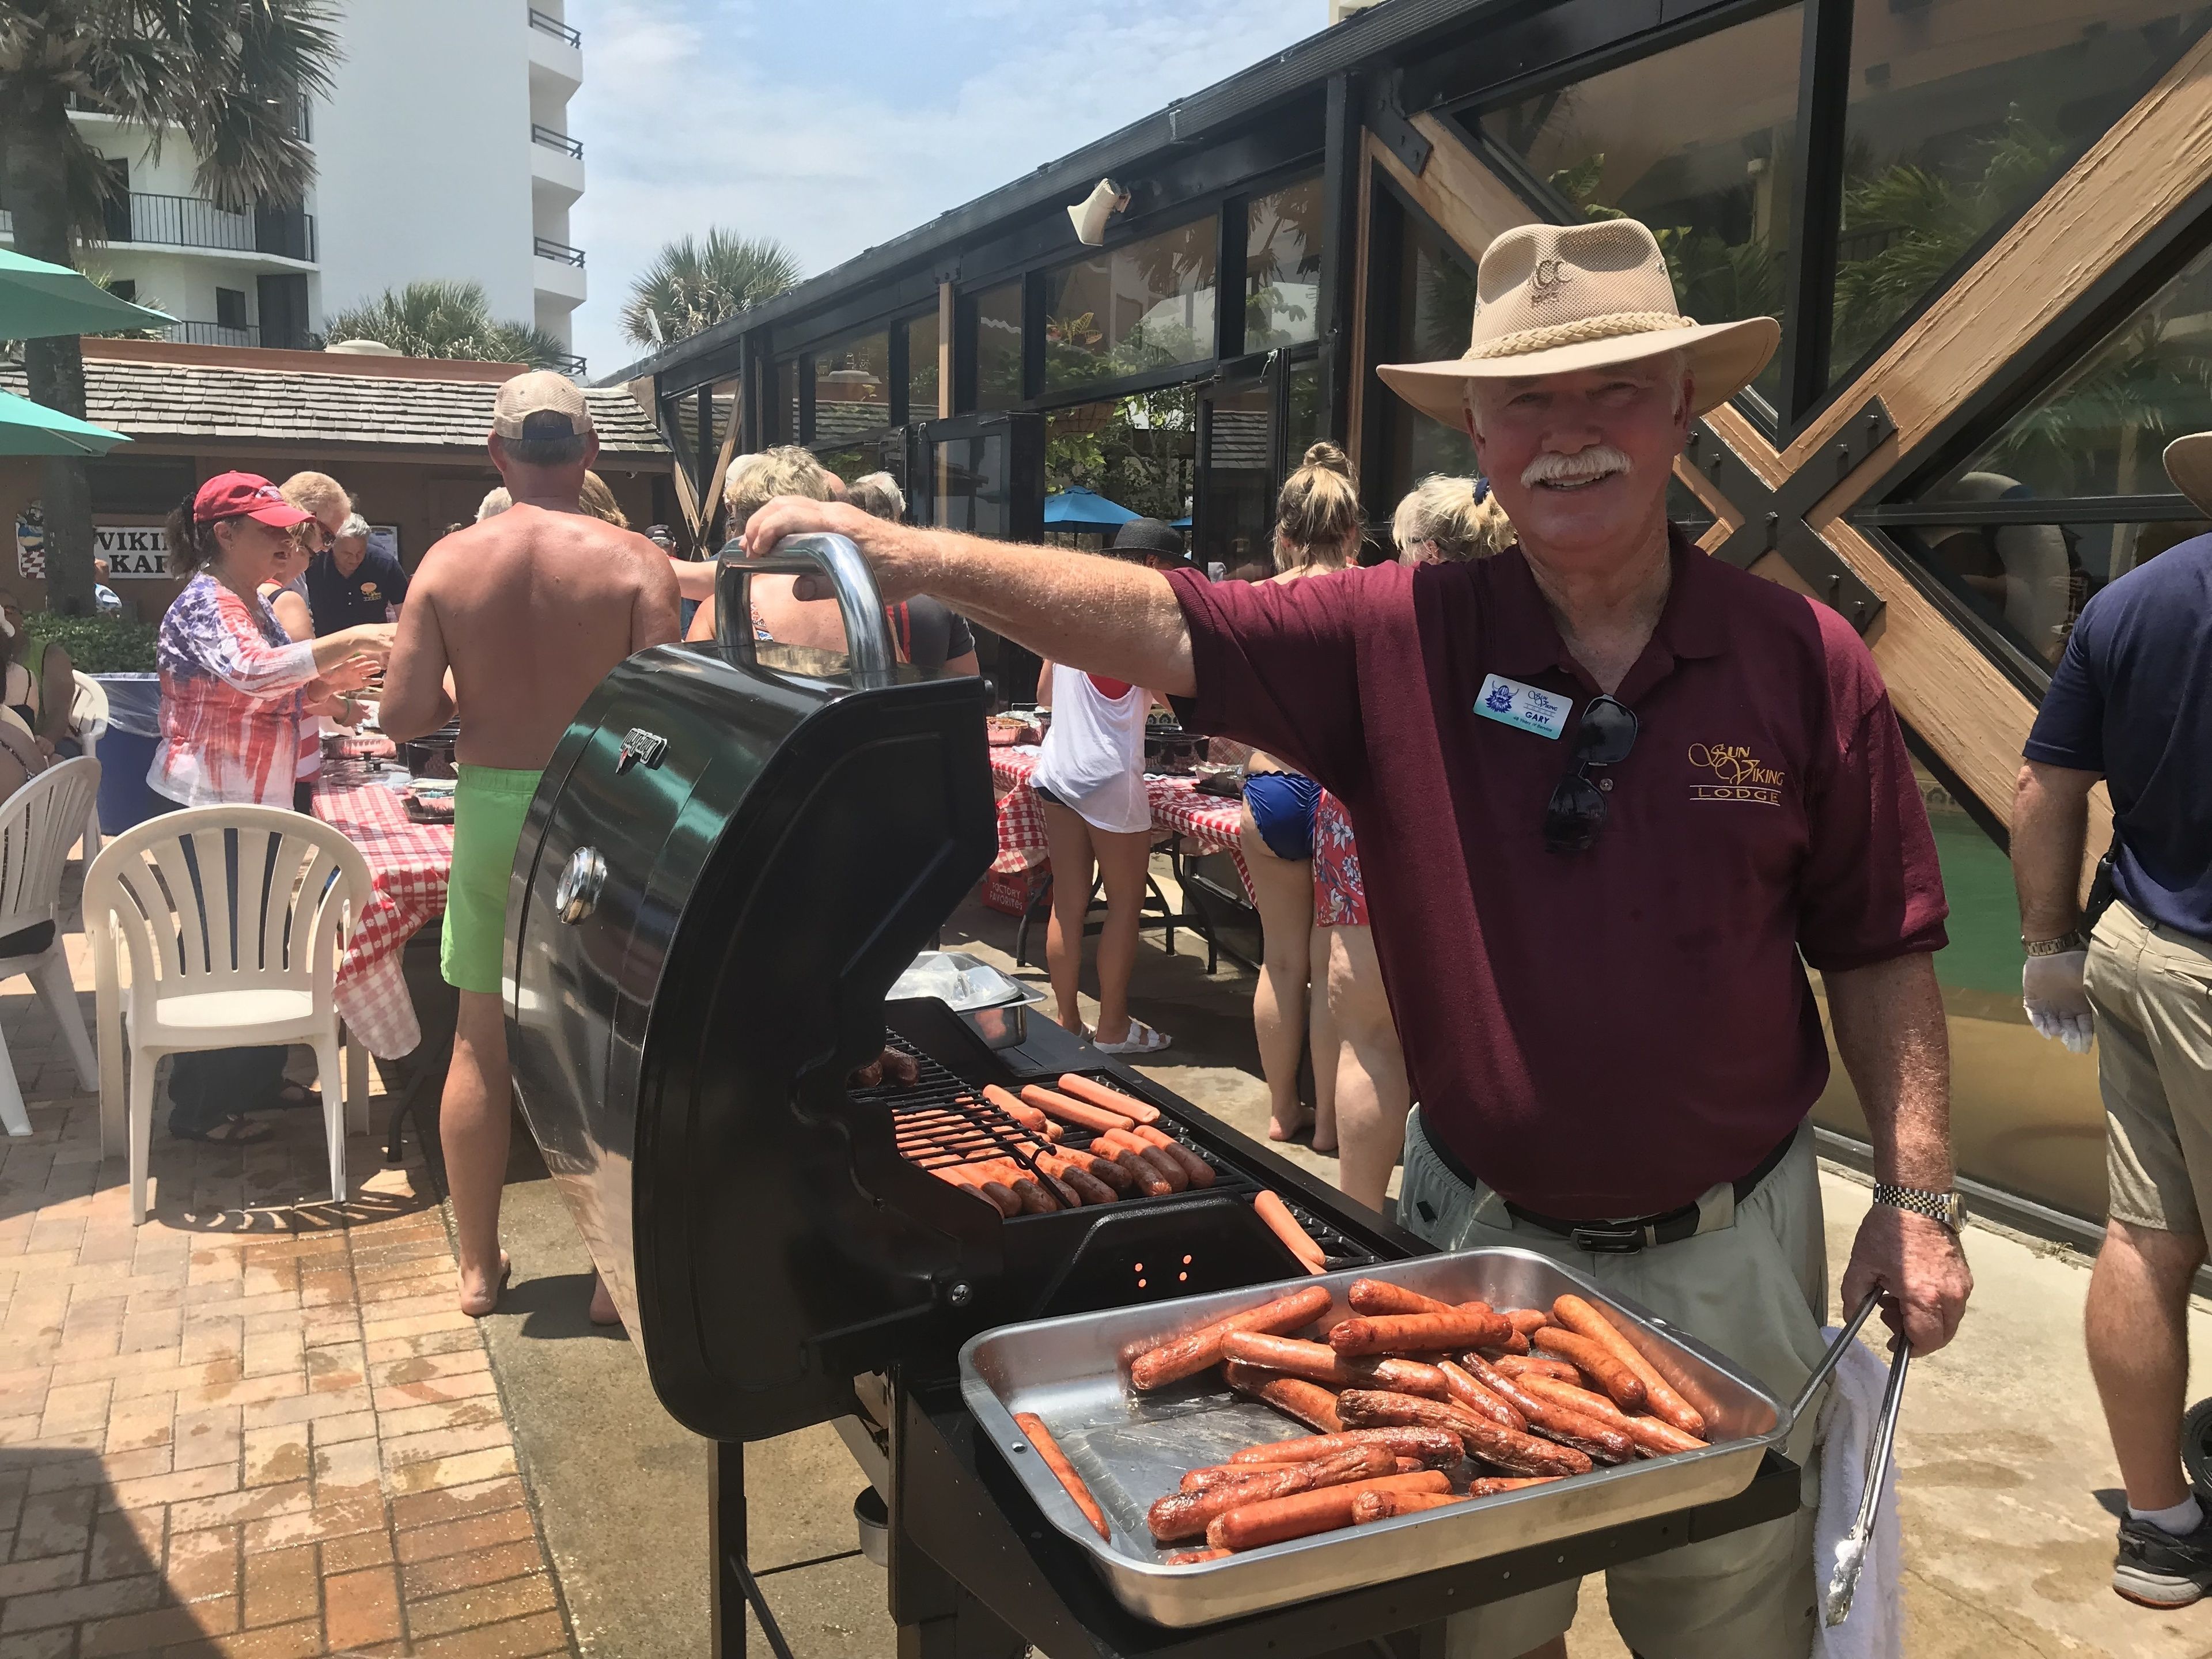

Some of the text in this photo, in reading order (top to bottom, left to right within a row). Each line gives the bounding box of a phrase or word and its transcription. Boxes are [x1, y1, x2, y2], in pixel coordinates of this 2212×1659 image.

[1525, 711, 1550, 724] GARY
[1537, 724, 1552, 732] Service
[1688, 743, 1751, 767] SUN
[1715, 756, 1785, 786] VIKING
[1698, 787, 1779, 803] LODGE
